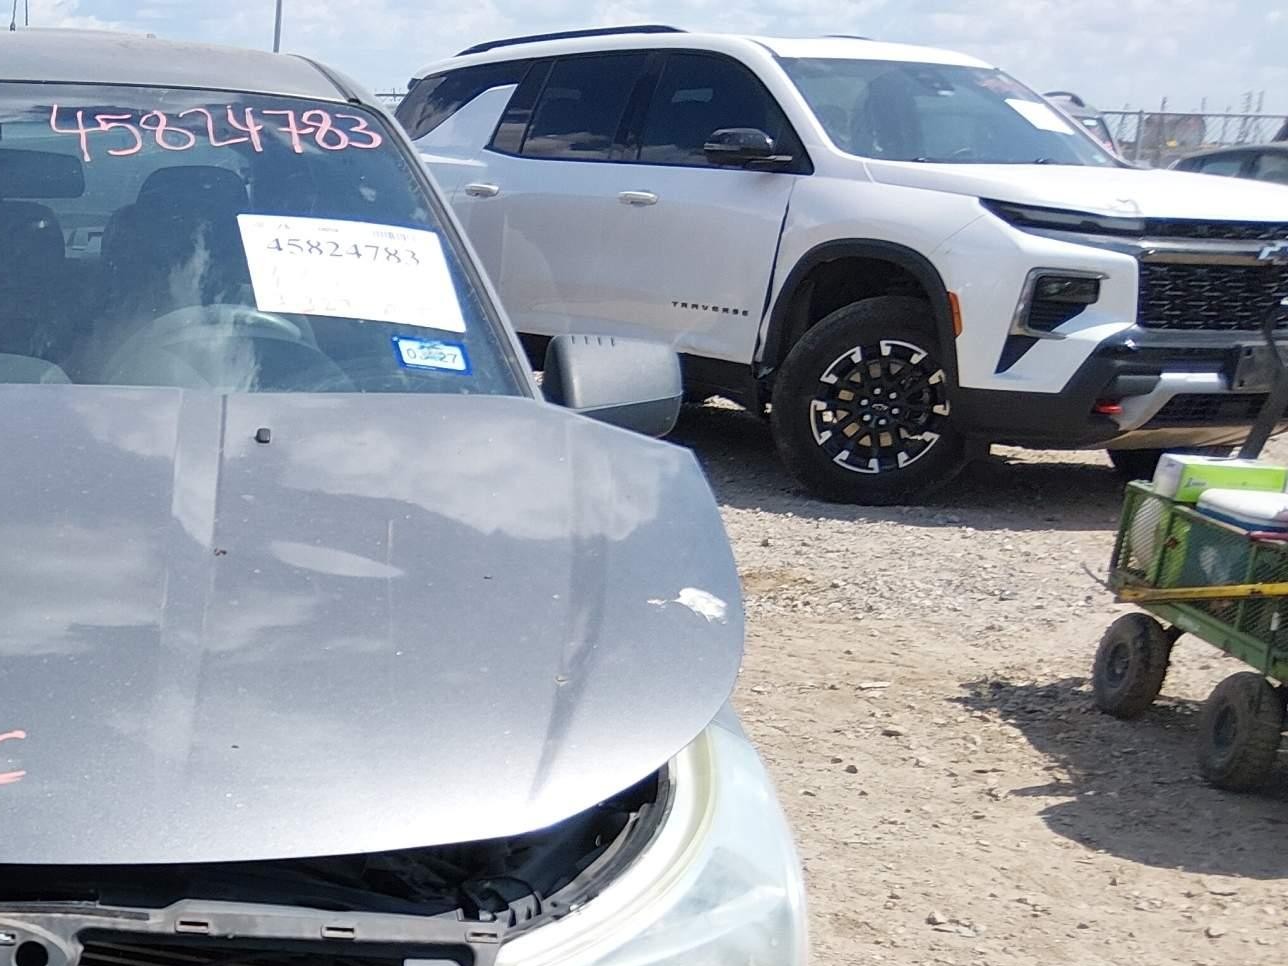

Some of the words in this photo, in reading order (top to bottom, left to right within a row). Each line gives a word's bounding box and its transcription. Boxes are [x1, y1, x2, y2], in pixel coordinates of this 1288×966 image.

[49, 103, 383, 162] 45824783
[266, 237, 420, 265] 45824783
[671, 301, 749, 316] TRAVERSE
